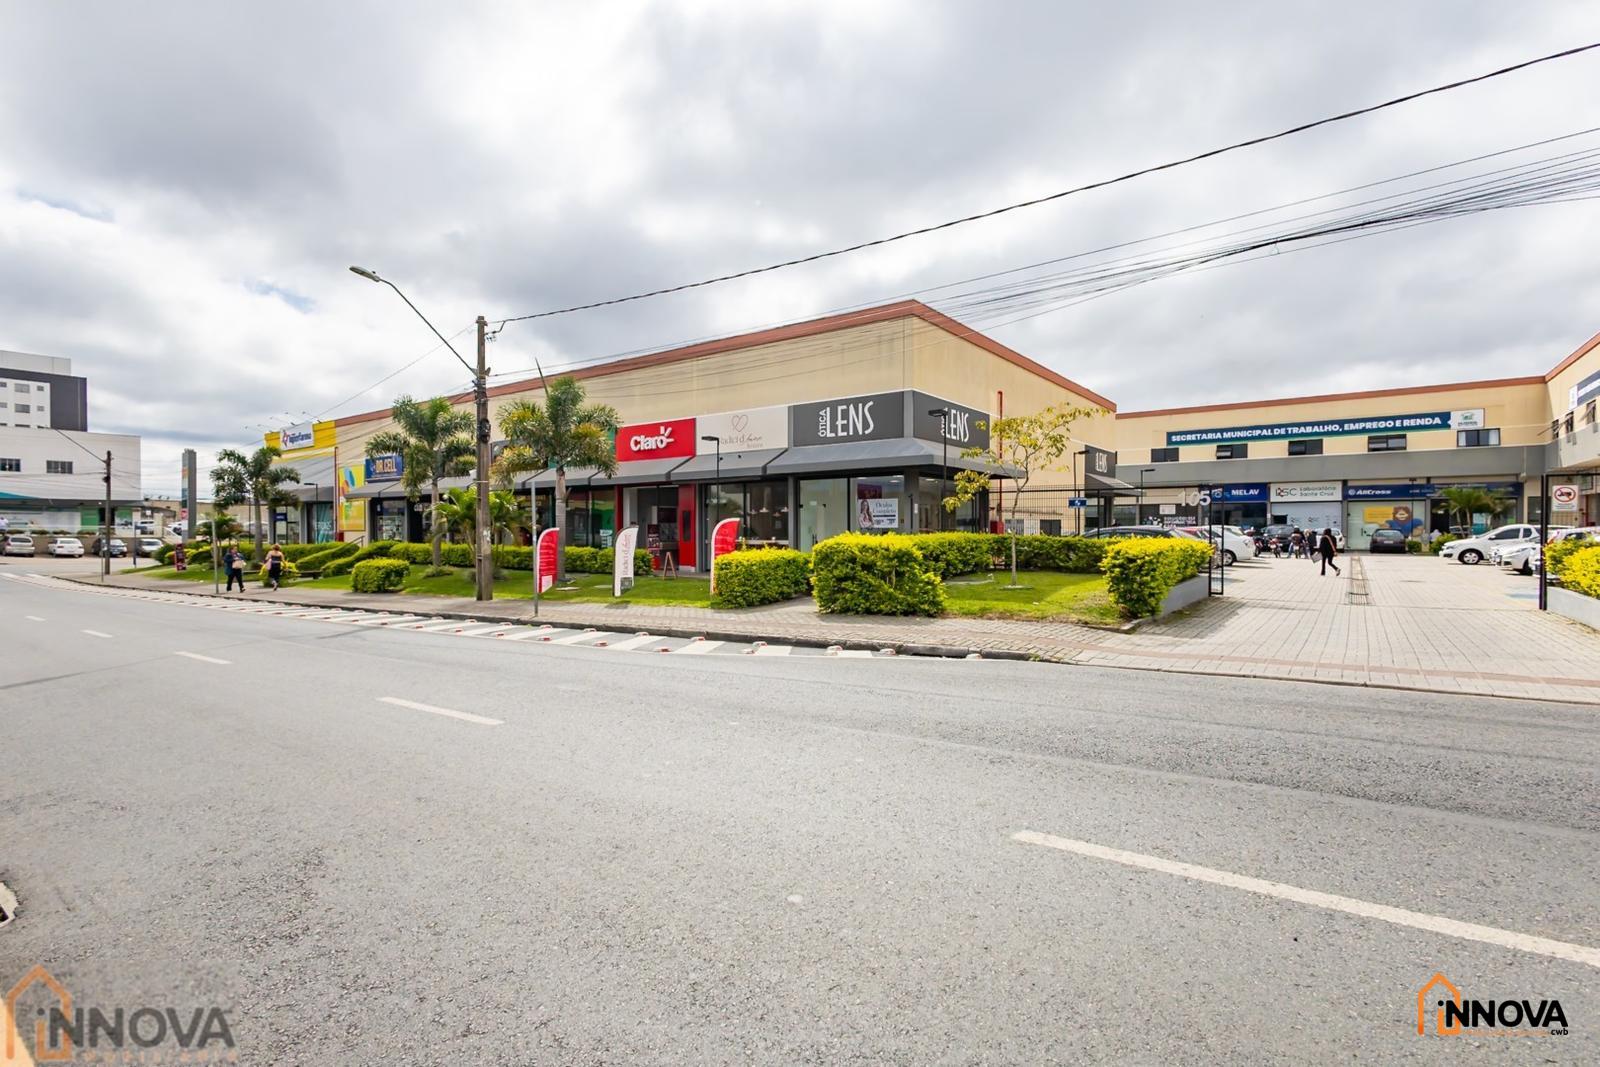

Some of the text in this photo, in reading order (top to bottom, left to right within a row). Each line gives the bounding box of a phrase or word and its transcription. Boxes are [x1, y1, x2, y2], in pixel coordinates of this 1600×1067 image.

[817, 409, 827, 437] ÓTICA
[826, 400, 874, 438] LENS
[945, 408, 969, 443] LENS
[1171, 433, 1222, 442] SECRETARIA
[1223, 429, 1273, 439] MUNICIPAL
[1274, 427, 1286, 435] DE
[1287, 424, 1343, 434] TRABALHO,
[1344, 420, 1394, 430] EMPREGO
[1403, 417, 1442, 427] RENDA
[630, 433, 668, 451] Claro
[1231, 488, 1260, 497] MELAV
